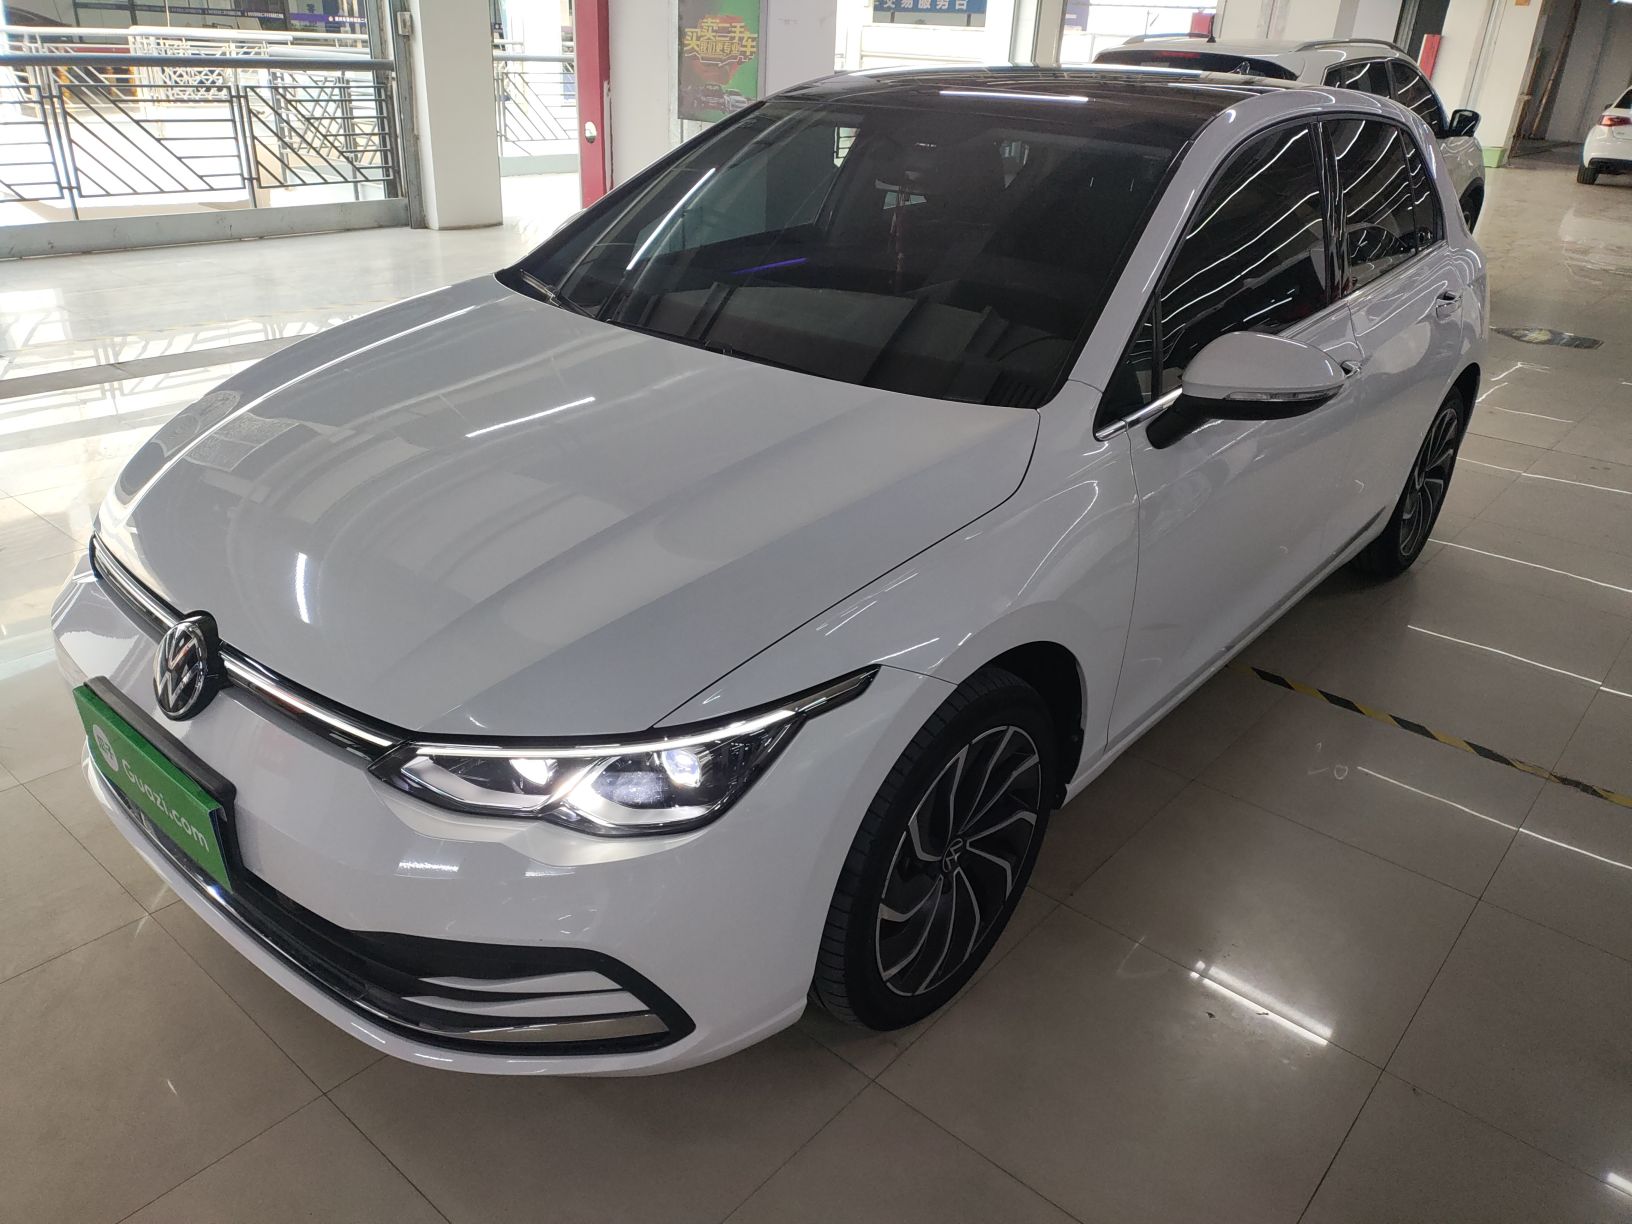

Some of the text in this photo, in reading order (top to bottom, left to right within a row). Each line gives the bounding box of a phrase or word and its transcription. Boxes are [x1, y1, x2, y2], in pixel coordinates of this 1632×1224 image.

[874, 0, 968, 9] 交易服务台
[121, 759, 210, 852] Guazi.com
